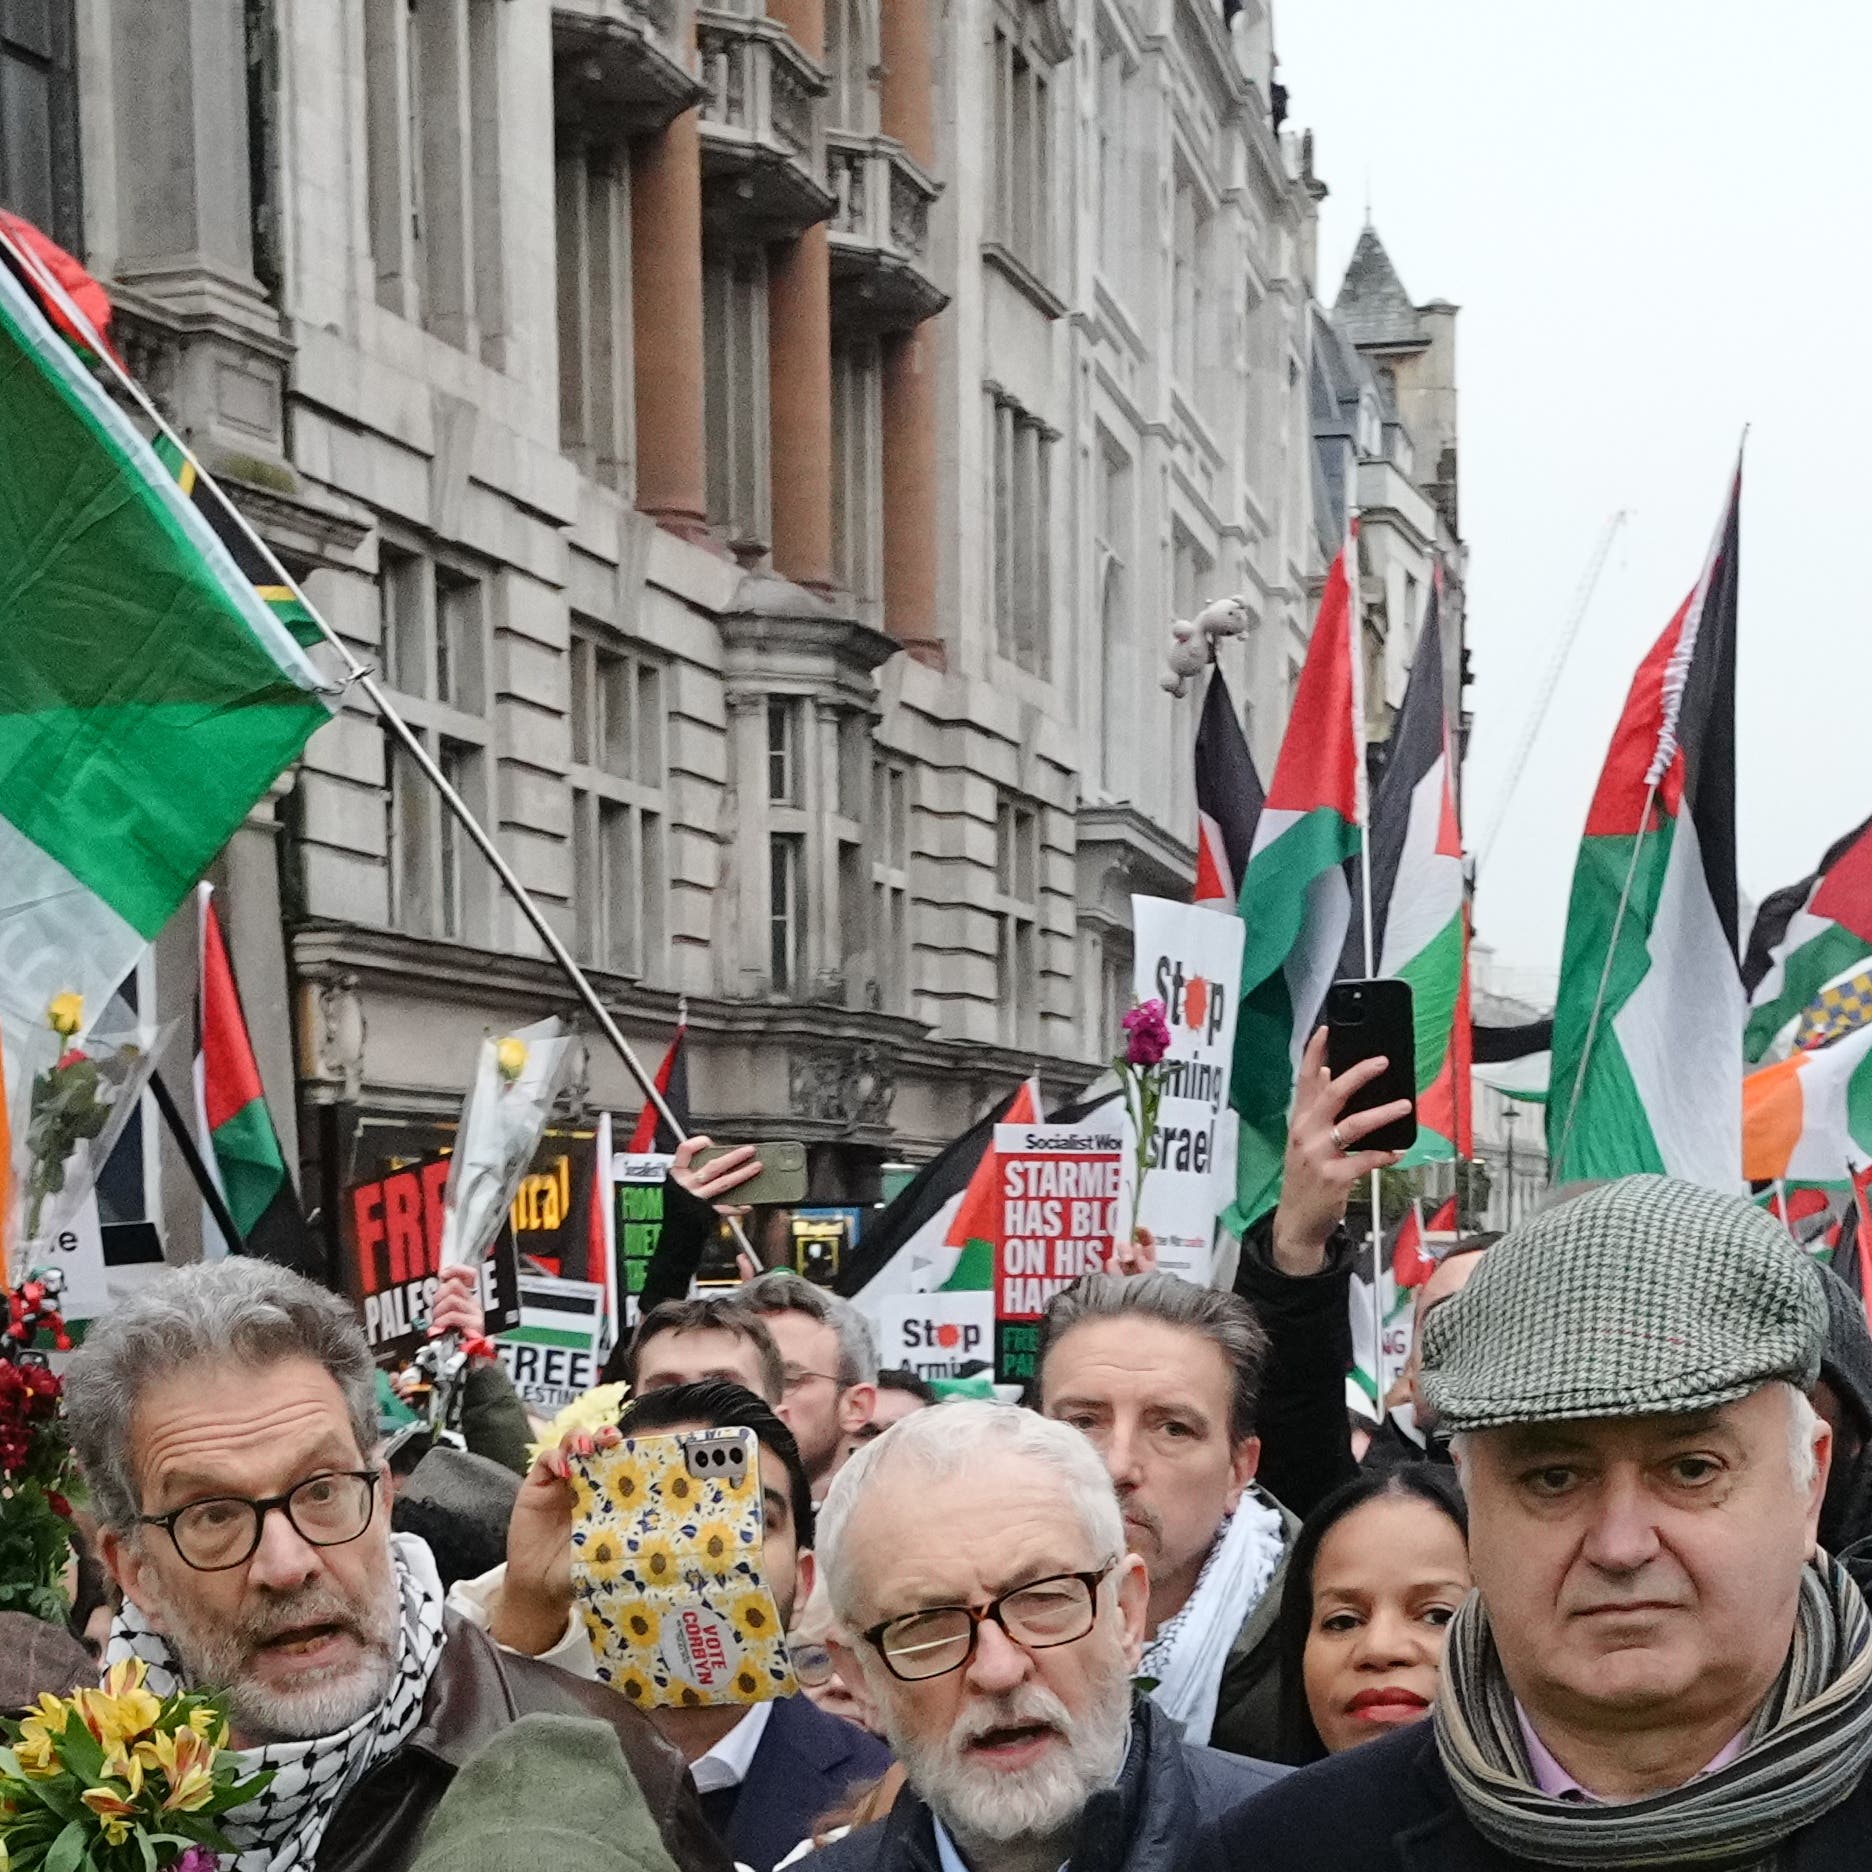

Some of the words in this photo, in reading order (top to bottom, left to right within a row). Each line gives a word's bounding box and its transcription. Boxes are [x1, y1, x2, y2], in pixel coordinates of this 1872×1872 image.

[1163, 1050, 1224, 1114] ming
[1025, 1133, 1094, 1151] Socialist
[1095, 1133, 1122, 1151] Wor
[1150, 1119, 1215, 1175] srael
[1003, 1160, 1122, 1199] STARME
[353, 1159, 478, 1294] FRE
[1003, 1200, 1063, 1237] HAS
[1070, 1200, 1120, 1239] BLO
[1002, 1238, 1047, 1277] ON
[1054, 1240, 1104, 1276] HIS
